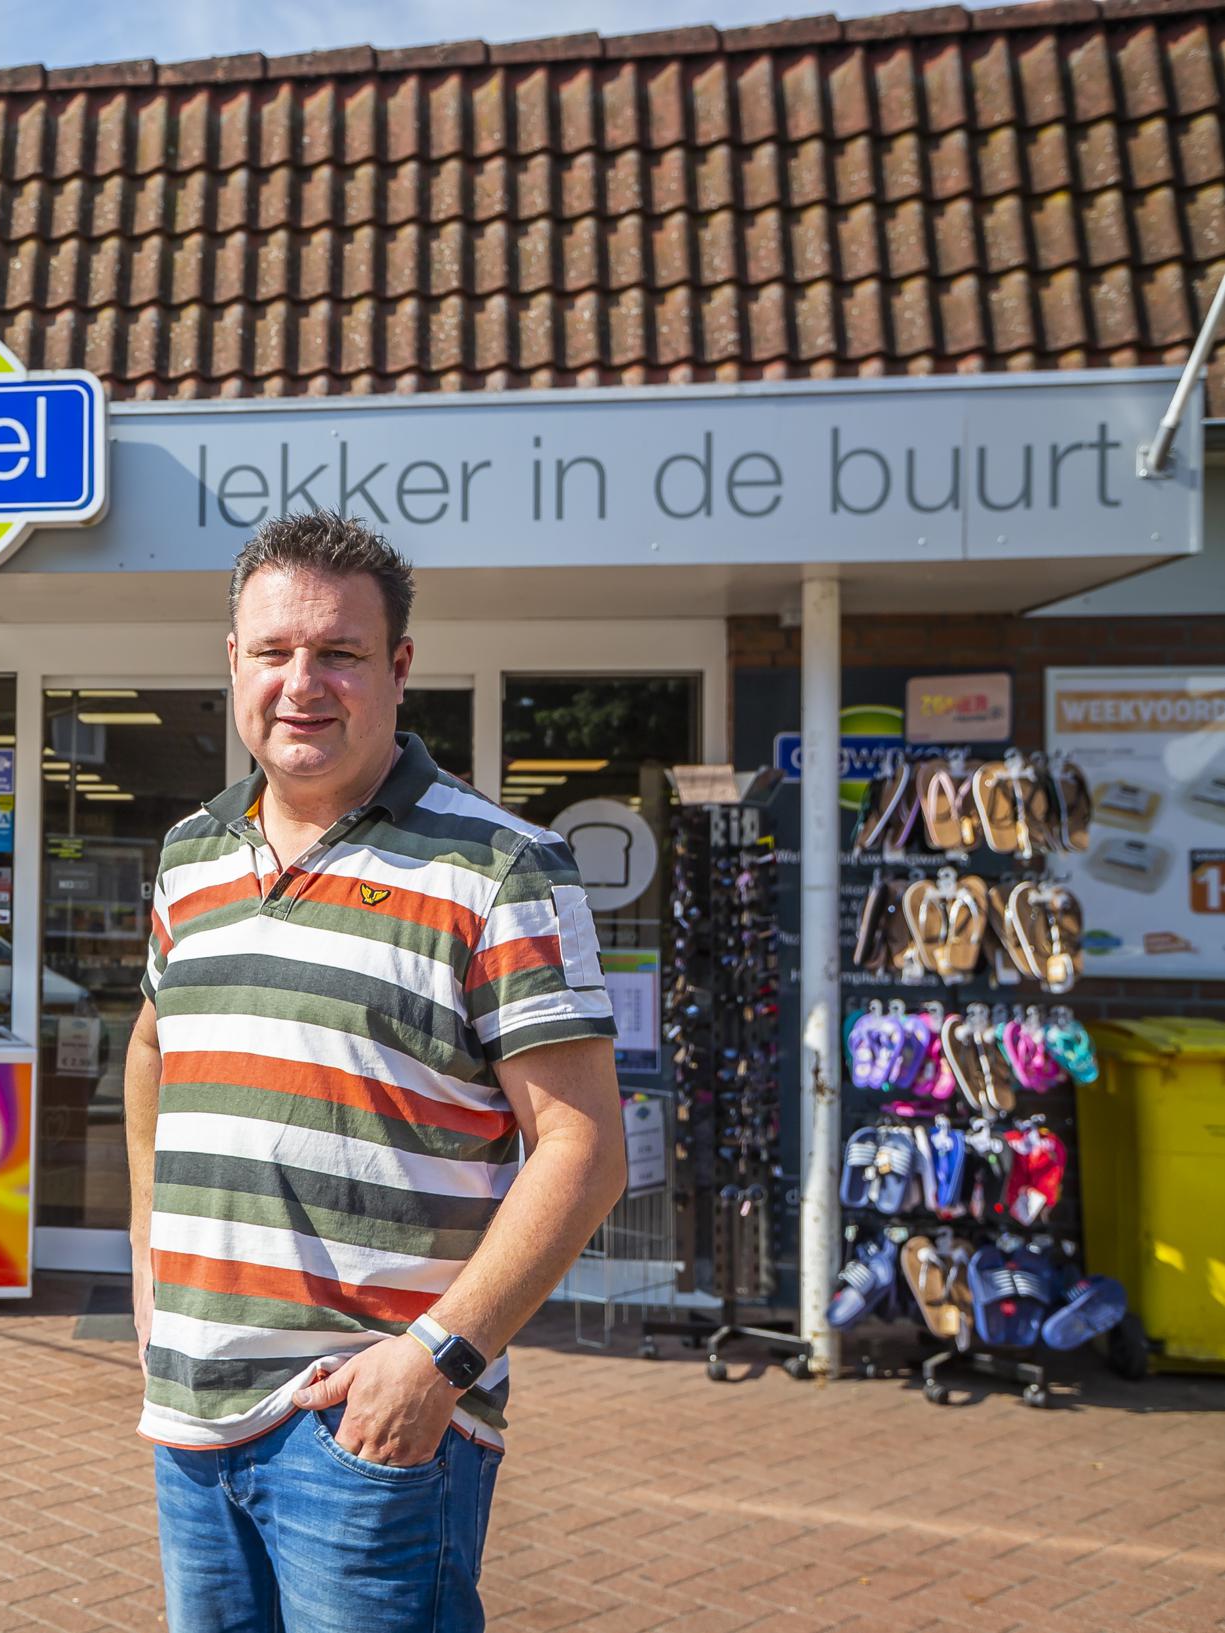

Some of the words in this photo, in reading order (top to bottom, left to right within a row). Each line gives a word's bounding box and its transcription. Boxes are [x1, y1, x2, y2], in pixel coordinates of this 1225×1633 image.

[199, 440, 492, 528] lekker
[533, 436, 607, 522] in
[654, 431, 783, 519] de
[830, 422, 1122, 515] buurt
